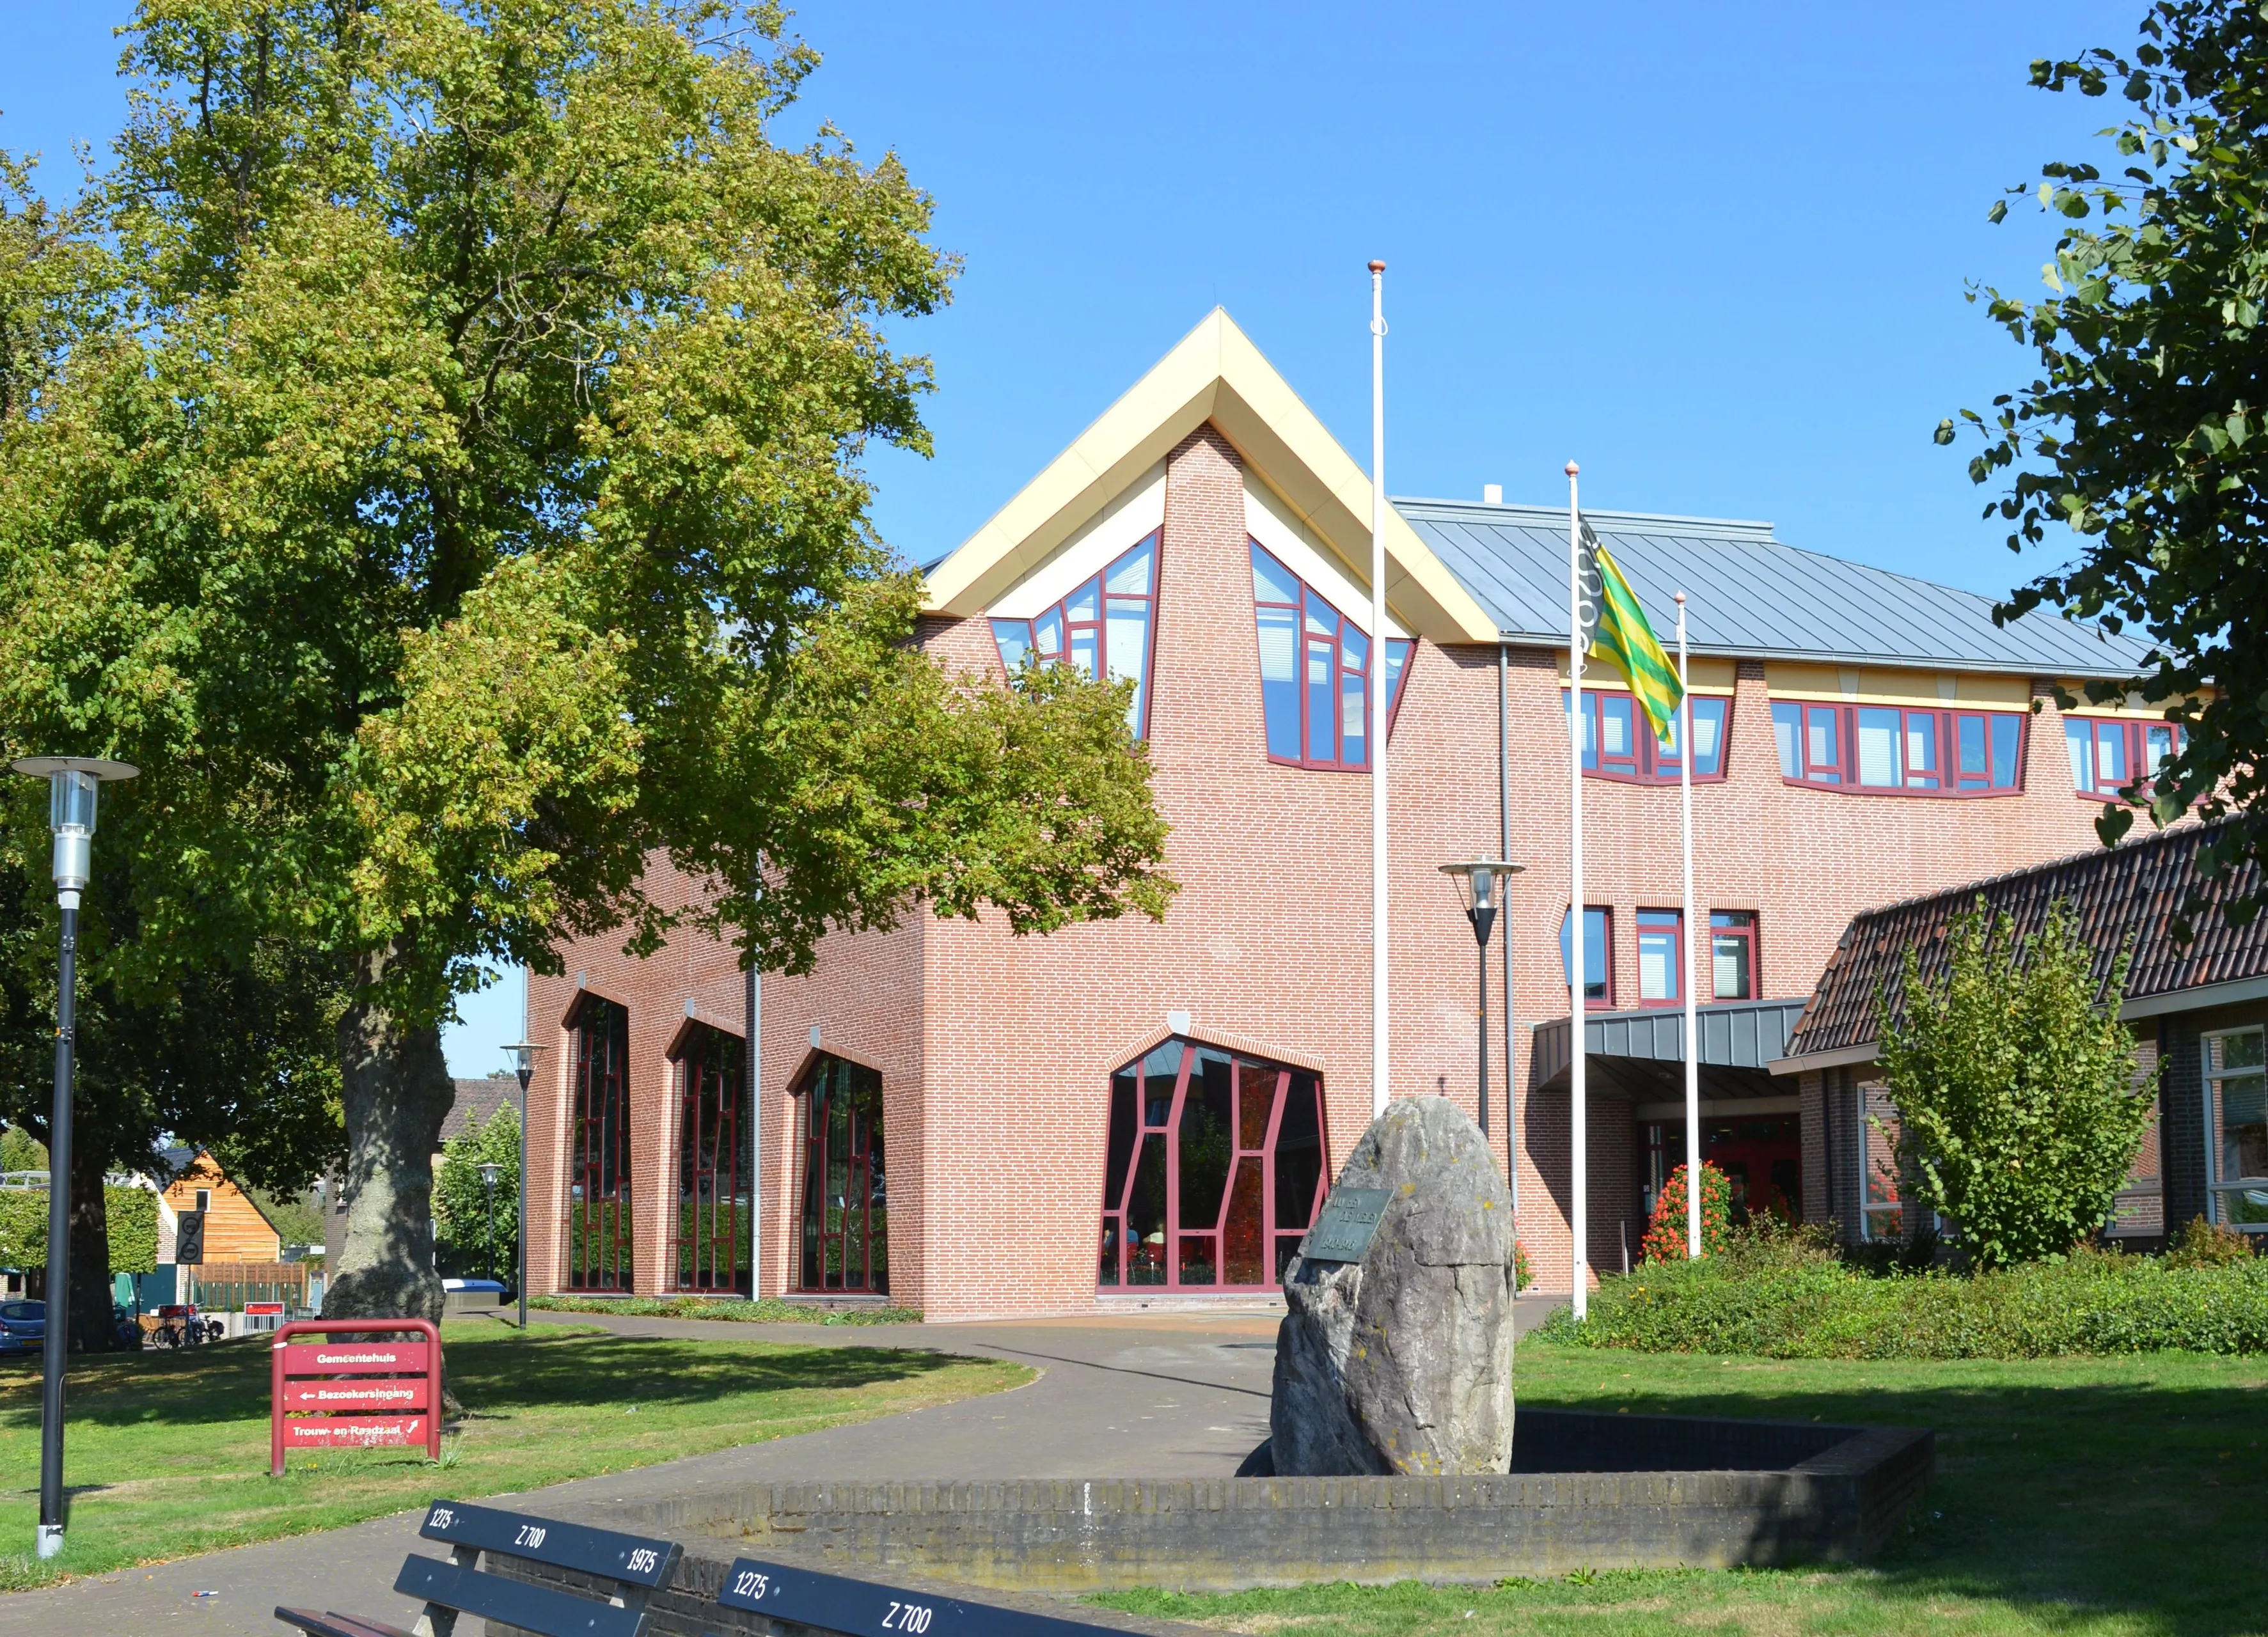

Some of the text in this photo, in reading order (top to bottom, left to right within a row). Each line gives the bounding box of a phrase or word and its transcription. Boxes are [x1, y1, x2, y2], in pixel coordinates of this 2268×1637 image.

[317, 1353, 397, 1364] Gemeentehuis
[317, 1388, 414, 1400] Bezoekersingang
[293, 1425, 401, 1437] Trouw- en Raadzaal
[429, 1508, 658, 1573] 1275 Z 700 1975
[733, 1570, 932, 1634] 1275 Z 700
